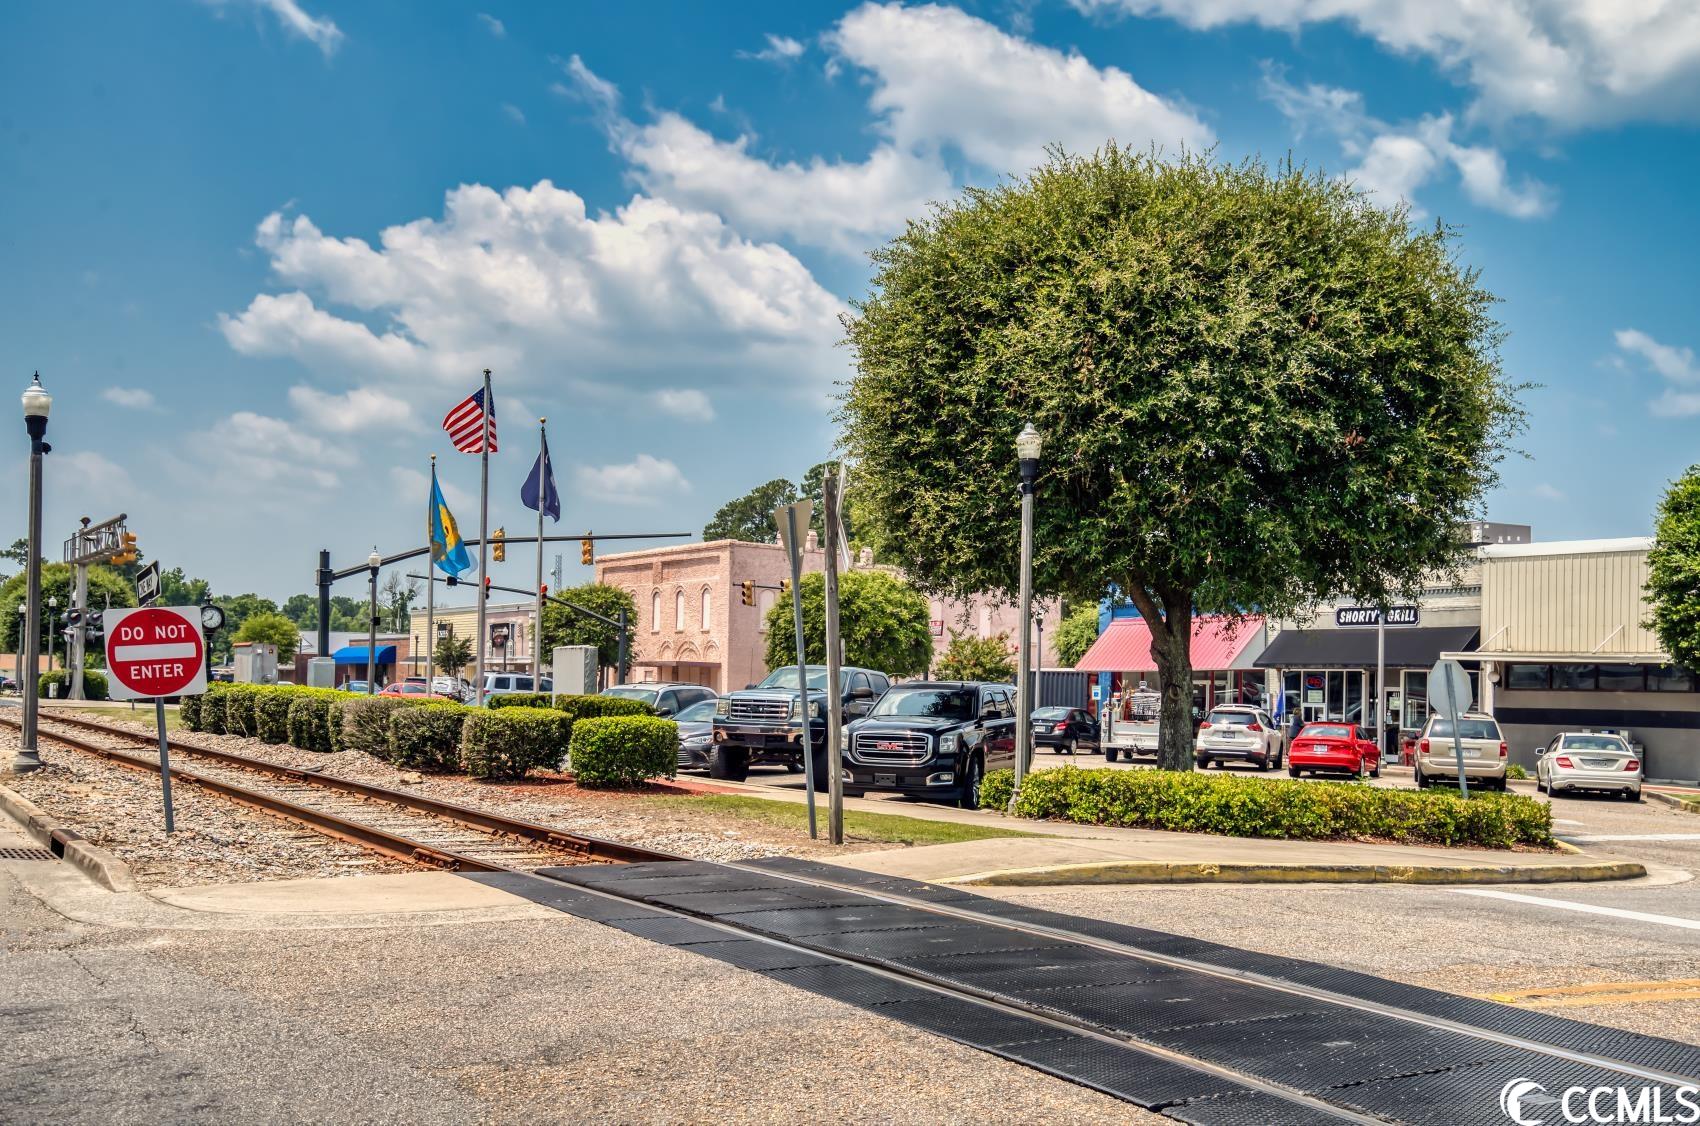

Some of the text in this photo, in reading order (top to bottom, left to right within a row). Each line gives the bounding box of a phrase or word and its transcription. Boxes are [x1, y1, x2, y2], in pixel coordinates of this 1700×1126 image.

[1340, 609, 1415, 623] SHORTY' GRILL
[121, 625, 187, 640] DO NOT
[130, 664, 184, 679] ENTER
[877, 742, 904, 751] GMC
